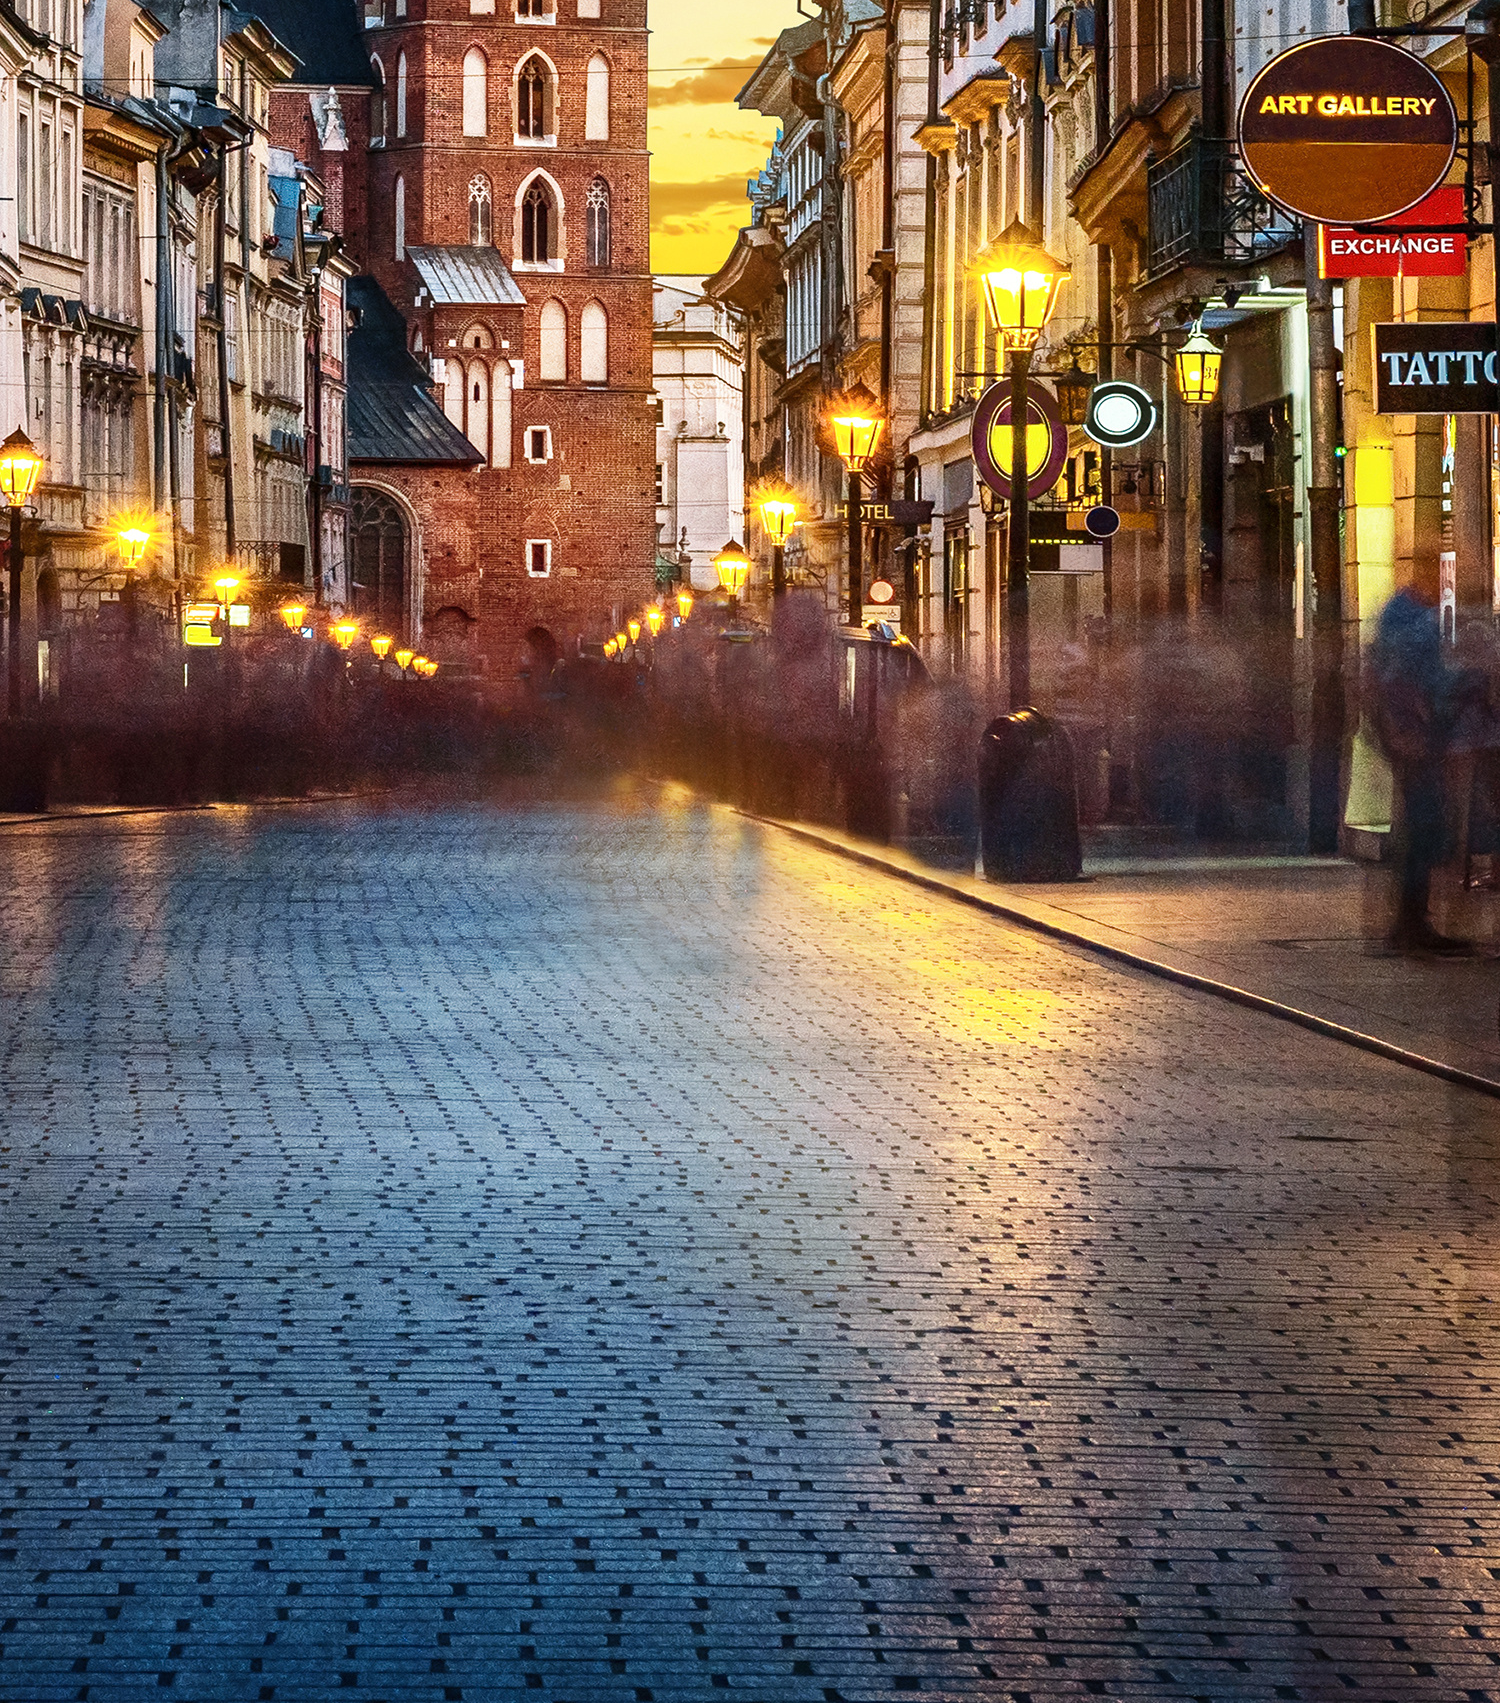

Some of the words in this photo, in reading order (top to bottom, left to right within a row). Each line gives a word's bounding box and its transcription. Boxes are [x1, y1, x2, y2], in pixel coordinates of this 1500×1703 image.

[1259, 95, 1313, 114] ART
[1317, 95, 1436, 115] GALLERY
[1330, 237, 1454, 255] EXCHANGE
